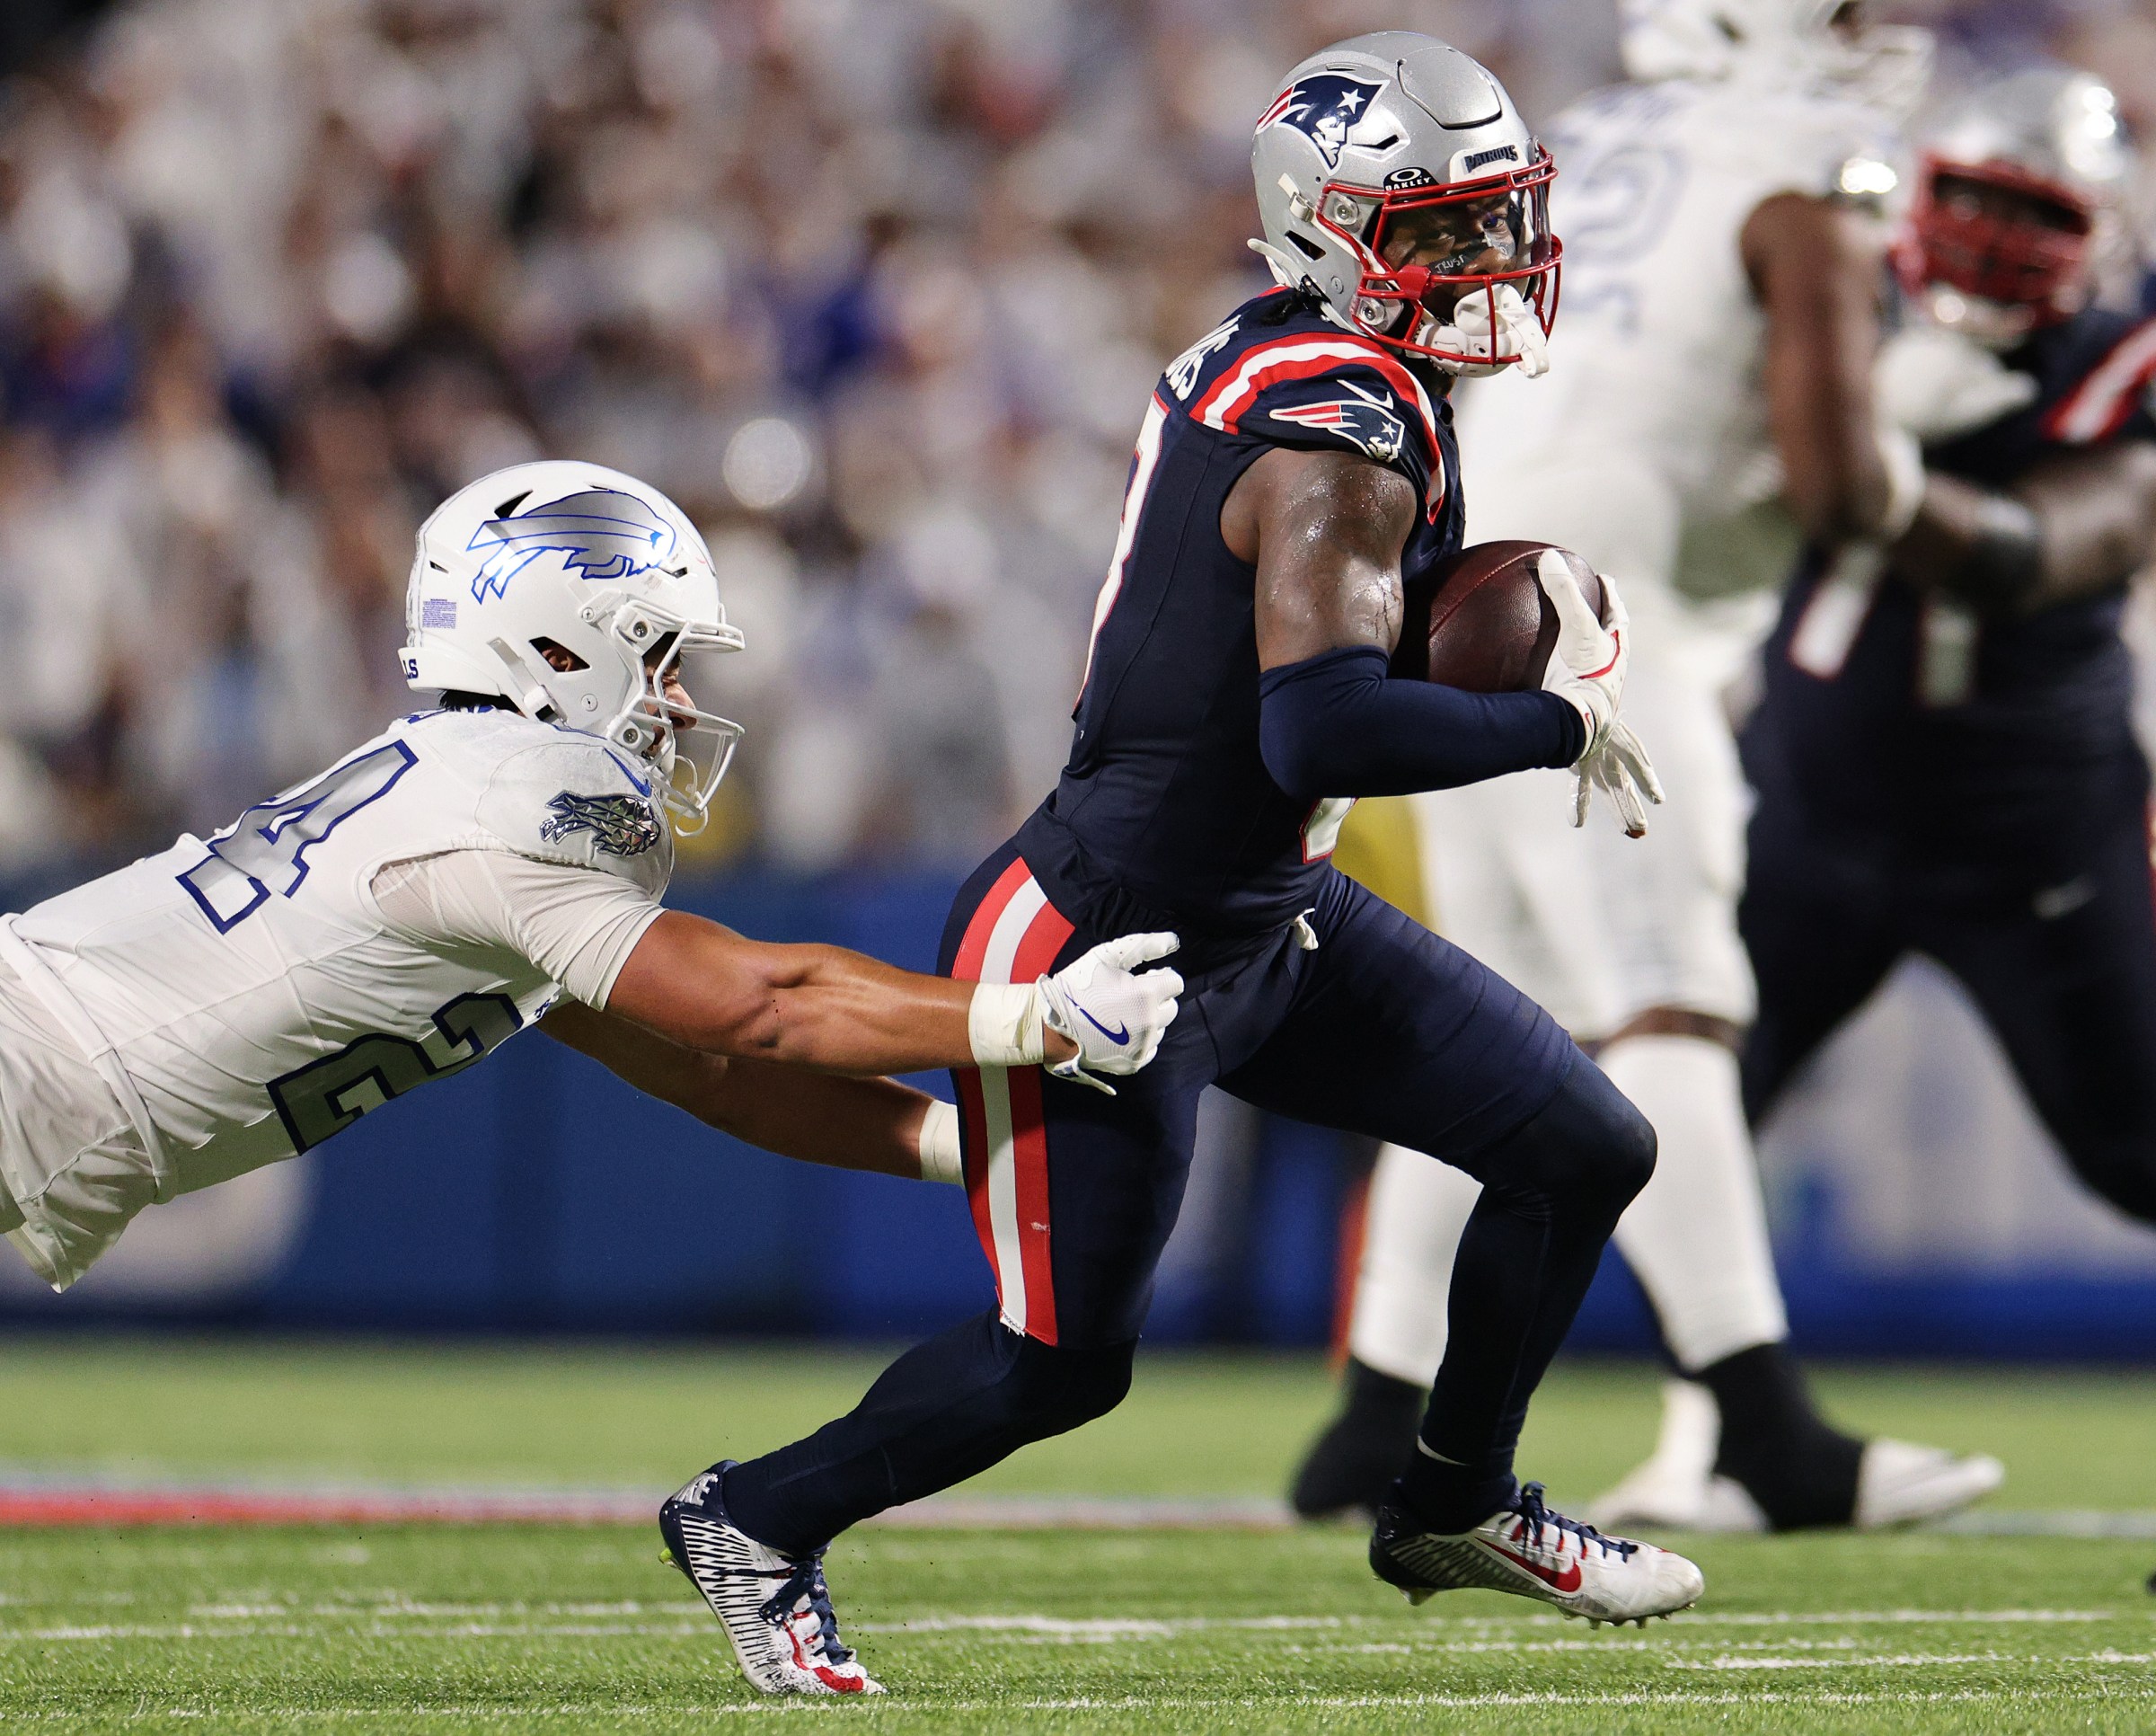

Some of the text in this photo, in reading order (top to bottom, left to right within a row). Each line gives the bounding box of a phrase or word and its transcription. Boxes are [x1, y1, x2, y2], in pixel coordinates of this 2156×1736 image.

[1464, 144, 1518, 173] PATRIOTS
[1384, 177, 1431, 190] OAKLEY
[1435, 254, 1466, 274] TRUST
[175, 739, 420, 935] 4
